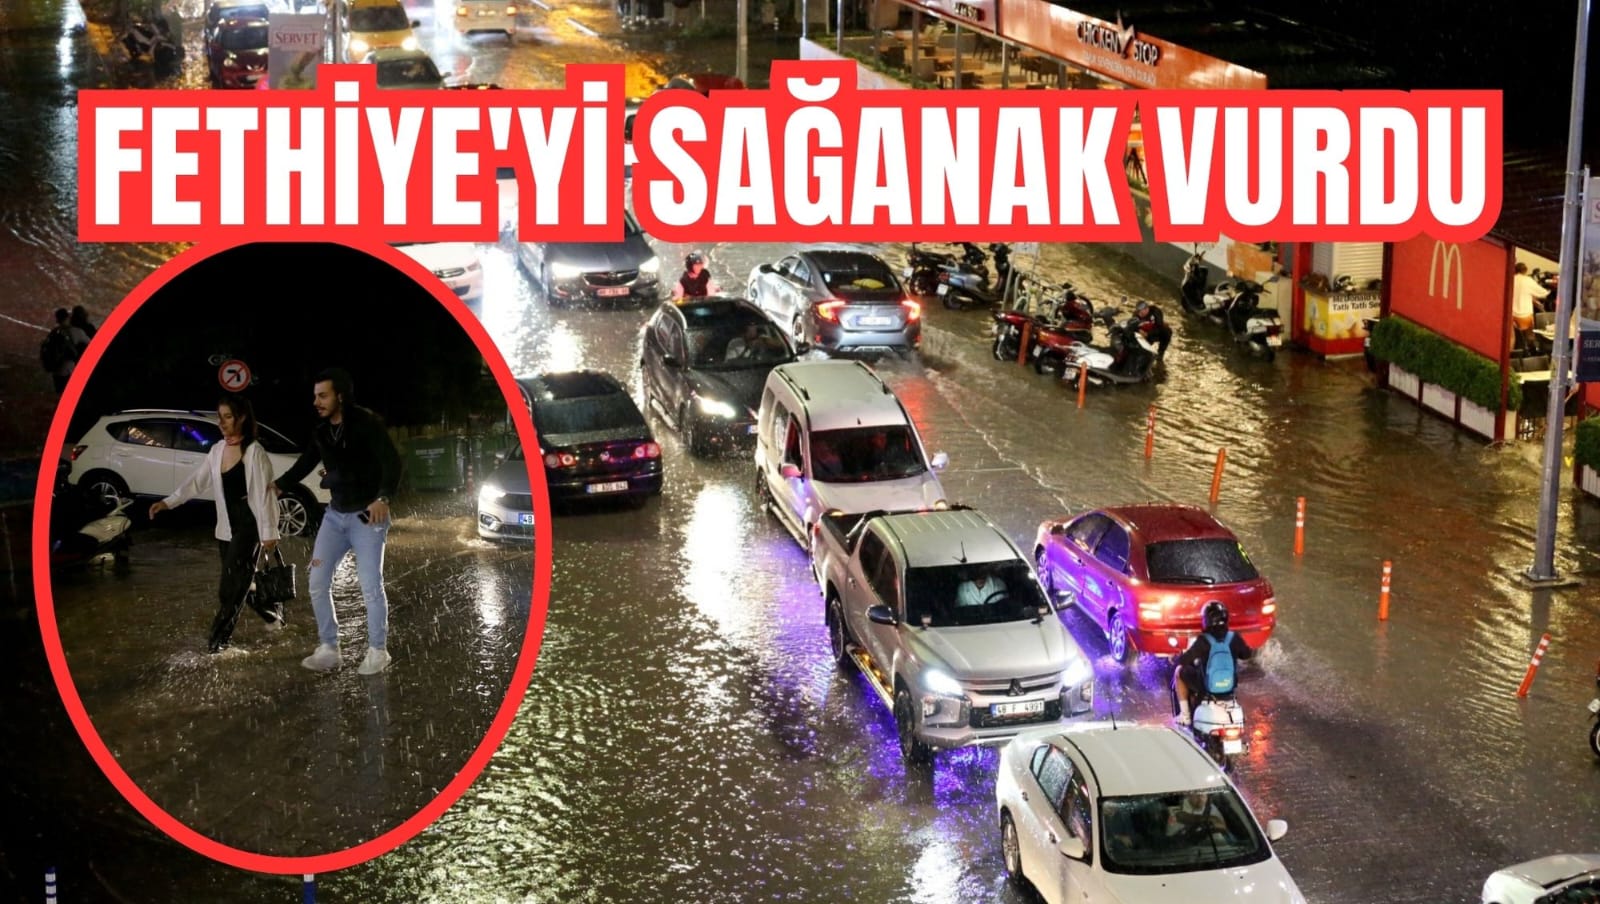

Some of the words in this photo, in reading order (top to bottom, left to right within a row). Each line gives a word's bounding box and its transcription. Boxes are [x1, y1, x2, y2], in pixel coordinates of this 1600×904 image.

[275, 31, 319, 45] SERVET
[1077, 21, 1120, 54] CHICKEN
[1133, 39, 1158, 66] STOP
